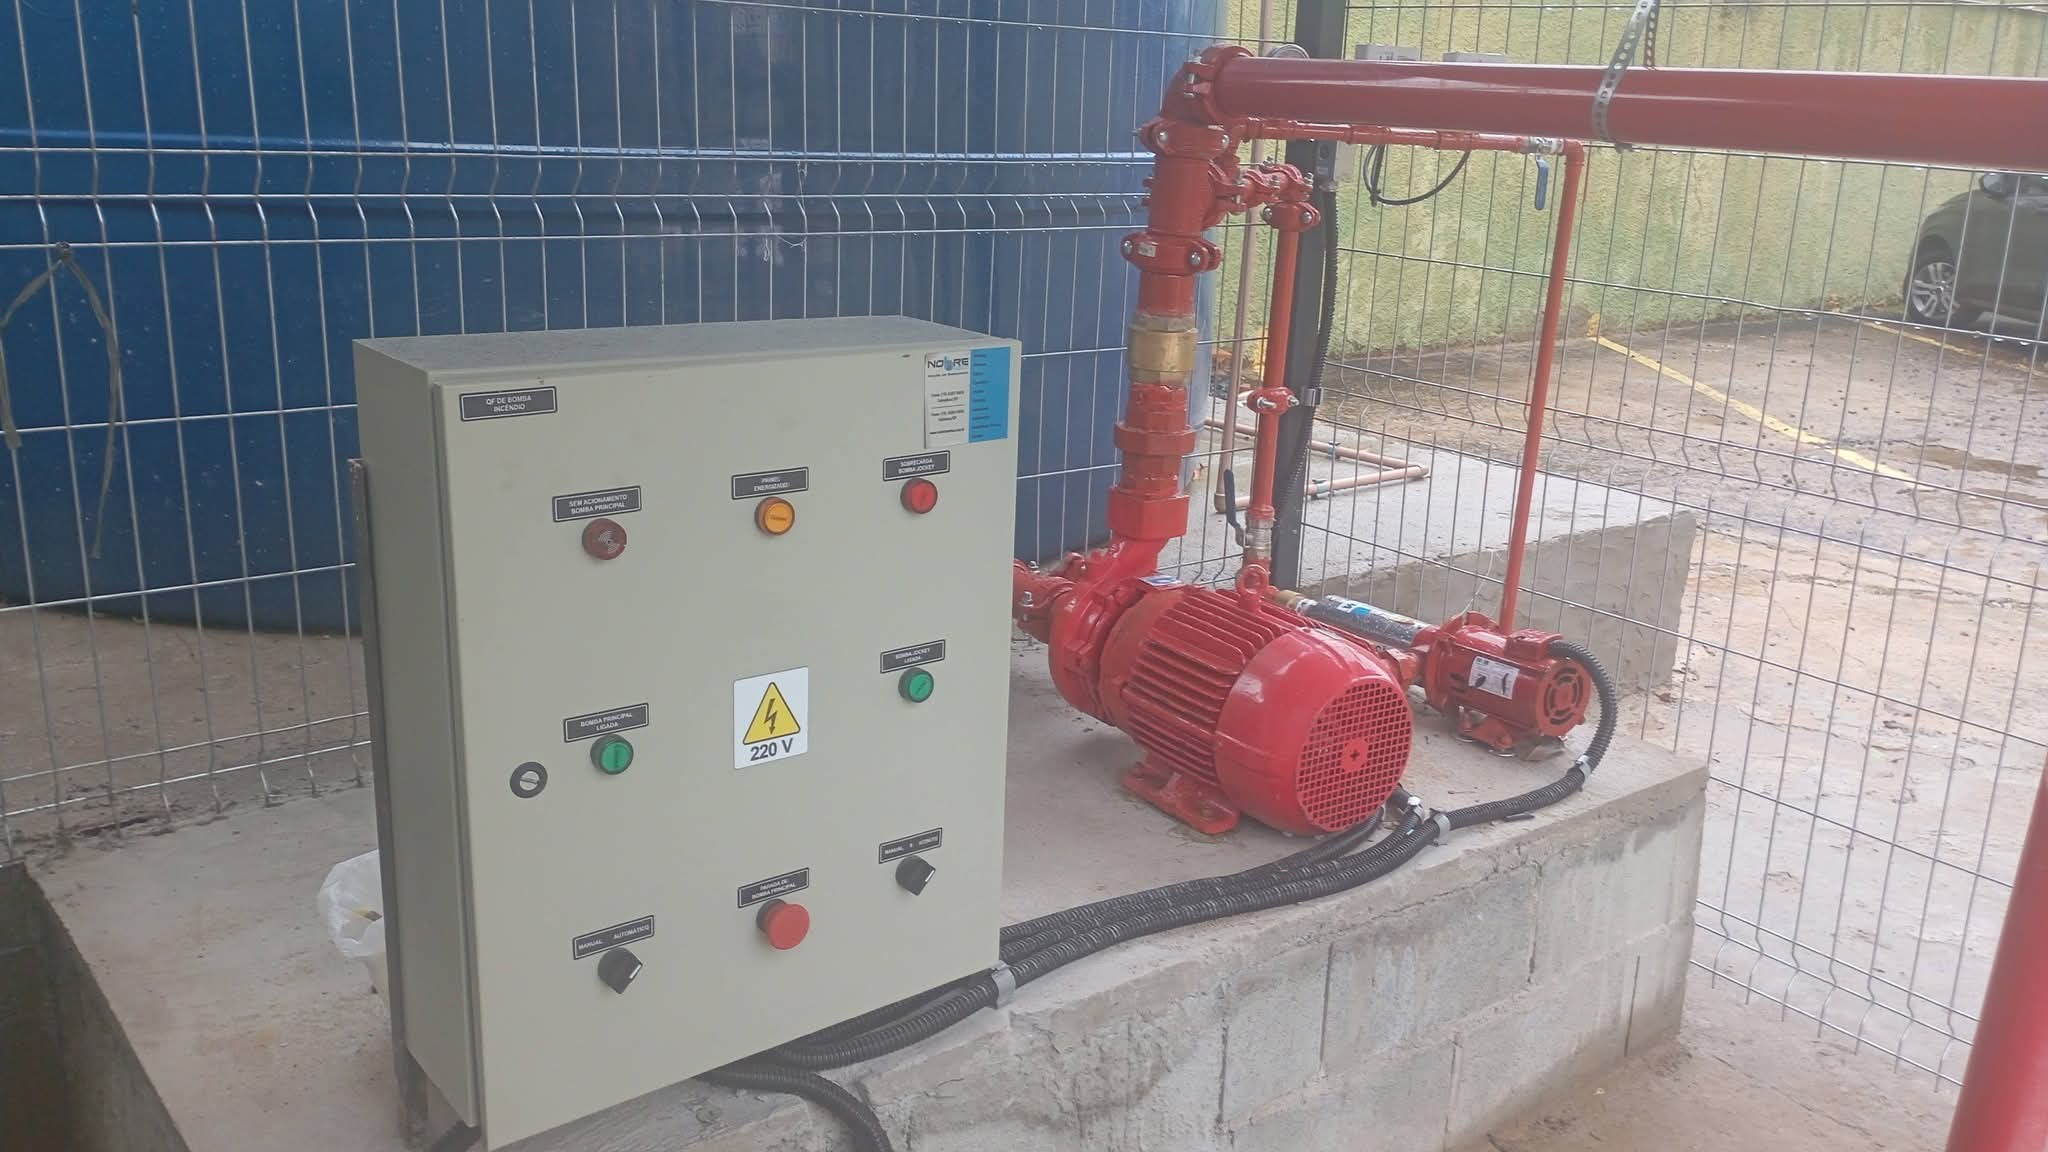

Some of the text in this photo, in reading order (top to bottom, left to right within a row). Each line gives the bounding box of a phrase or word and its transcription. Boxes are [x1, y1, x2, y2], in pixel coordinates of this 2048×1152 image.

[507, 395, 532, 403] BOMBA
[583, 494, 628, 505] ACIONAMENTO
[571, 502, 625, 514] BOMBA PRINCIPAL
[750, 737, 793, 761] 220 V
